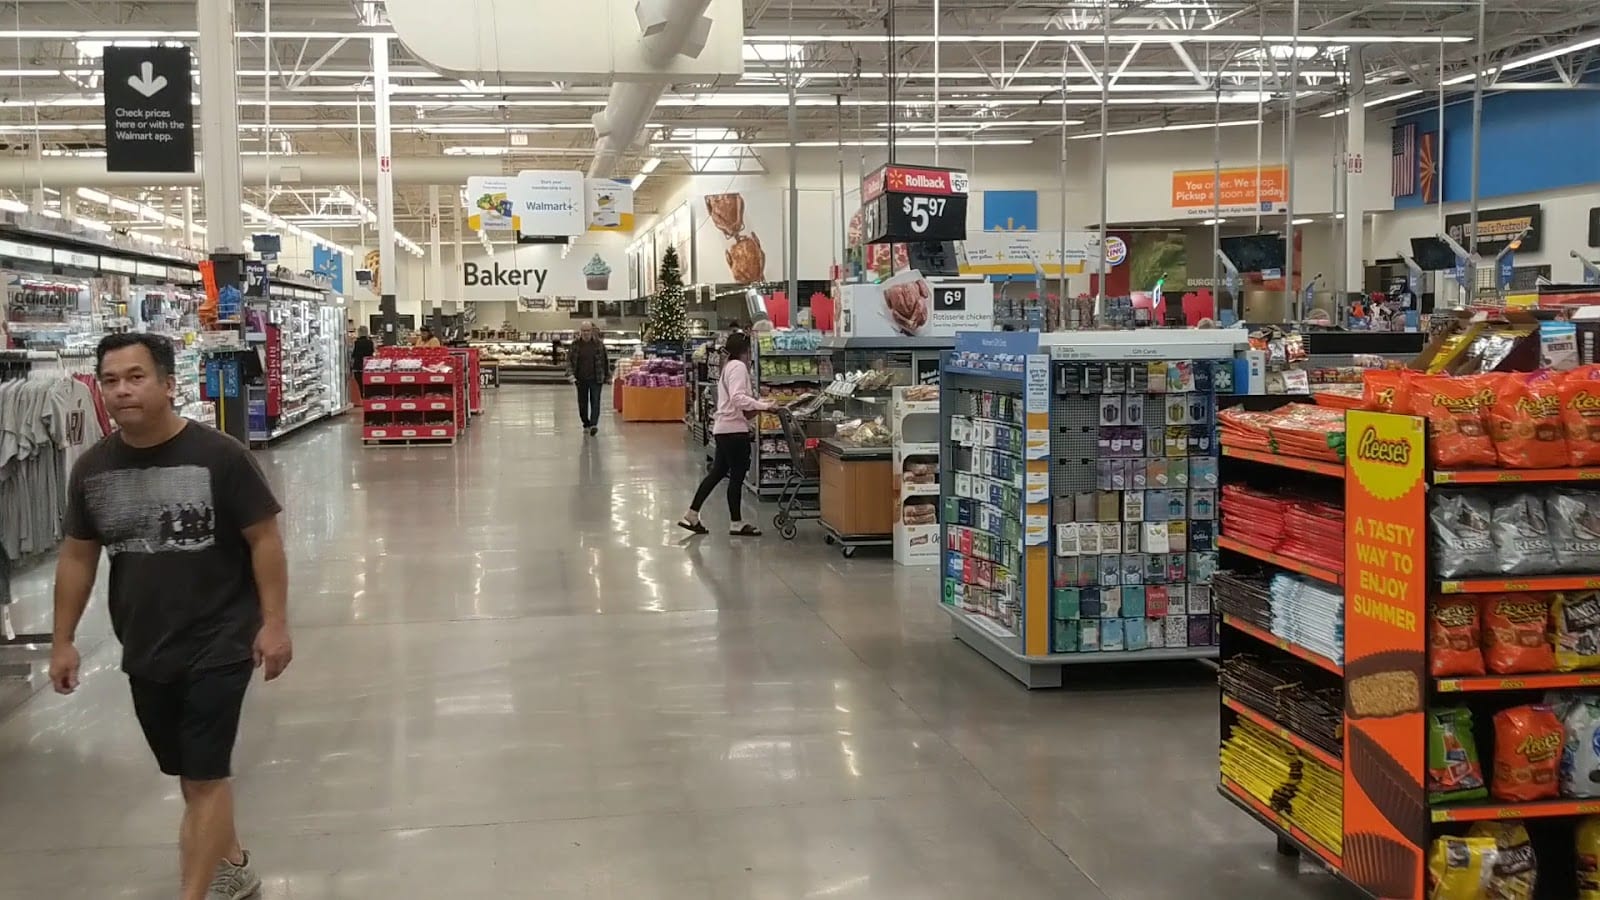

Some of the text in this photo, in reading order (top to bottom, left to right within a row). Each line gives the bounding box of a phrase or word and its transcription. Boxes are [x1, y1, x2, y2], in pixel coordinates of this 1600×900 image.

[115, 107, 171, 119] Check prices
[115, 120, 135, 128] here
[149, 120, 168, 128] with
[170, 120, 185, 129] the
[115, 131, 173, 142] Walmart app.
[905, 174, 946, 189] Rollback
[1186, 178, 1276, 190] You orer. We sop.
[1176, 191, 1207, 201] Pickup
[1220, 190, 1244, 198] soon
[464, 262, 548, 293] Bakery
[933, 312, 993, 320] Rotisserie chicken
[1358, 427, 1410, 464] Reese's
[1355, 516, 1415, 547] A TASTY
[1356, 542, 1413, 574] WAY TO
[1360, 570, 1408, 600] ENJOY
[1354, 594, 1416, 632] SUMMER
